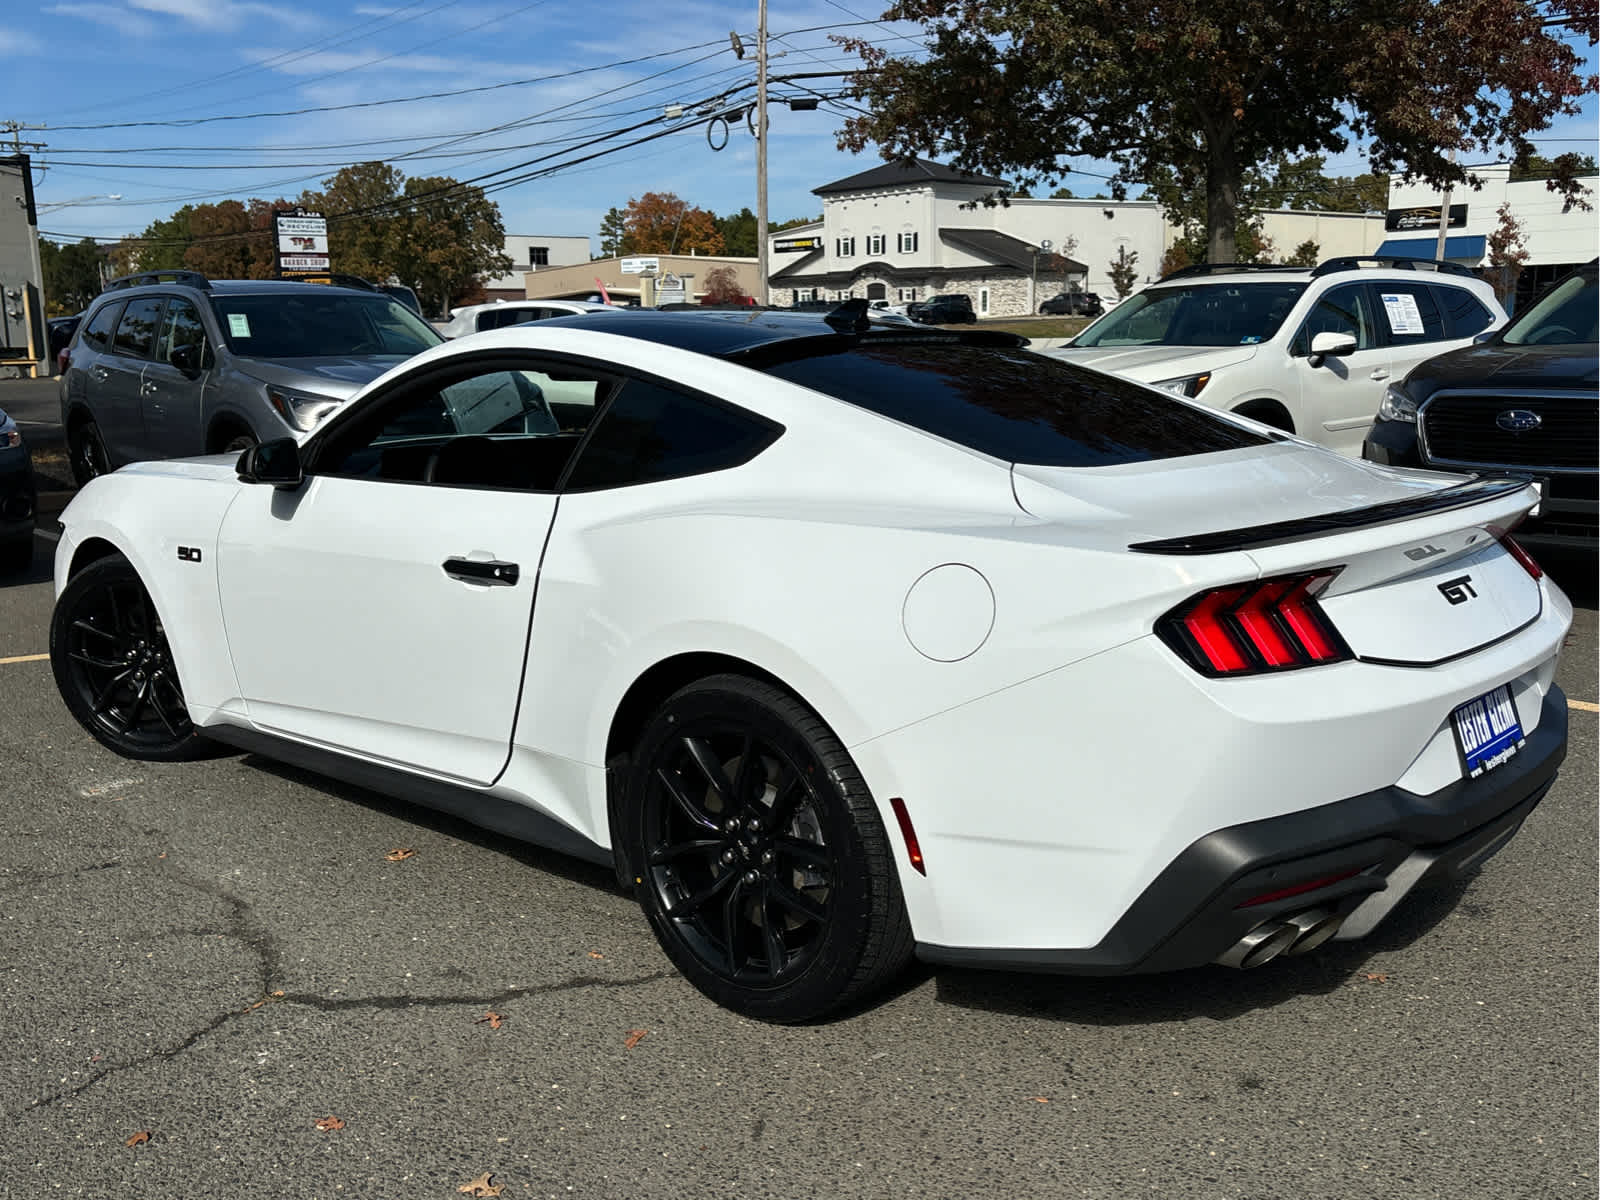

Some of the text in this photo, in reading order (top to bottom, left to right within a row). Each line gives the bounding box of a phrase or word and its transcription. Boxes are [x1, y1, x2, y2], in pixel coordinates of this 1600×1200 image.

[1437, 574, 1478, 606] GT
[1455, 684, 1518, 755] LESTER GLENN
